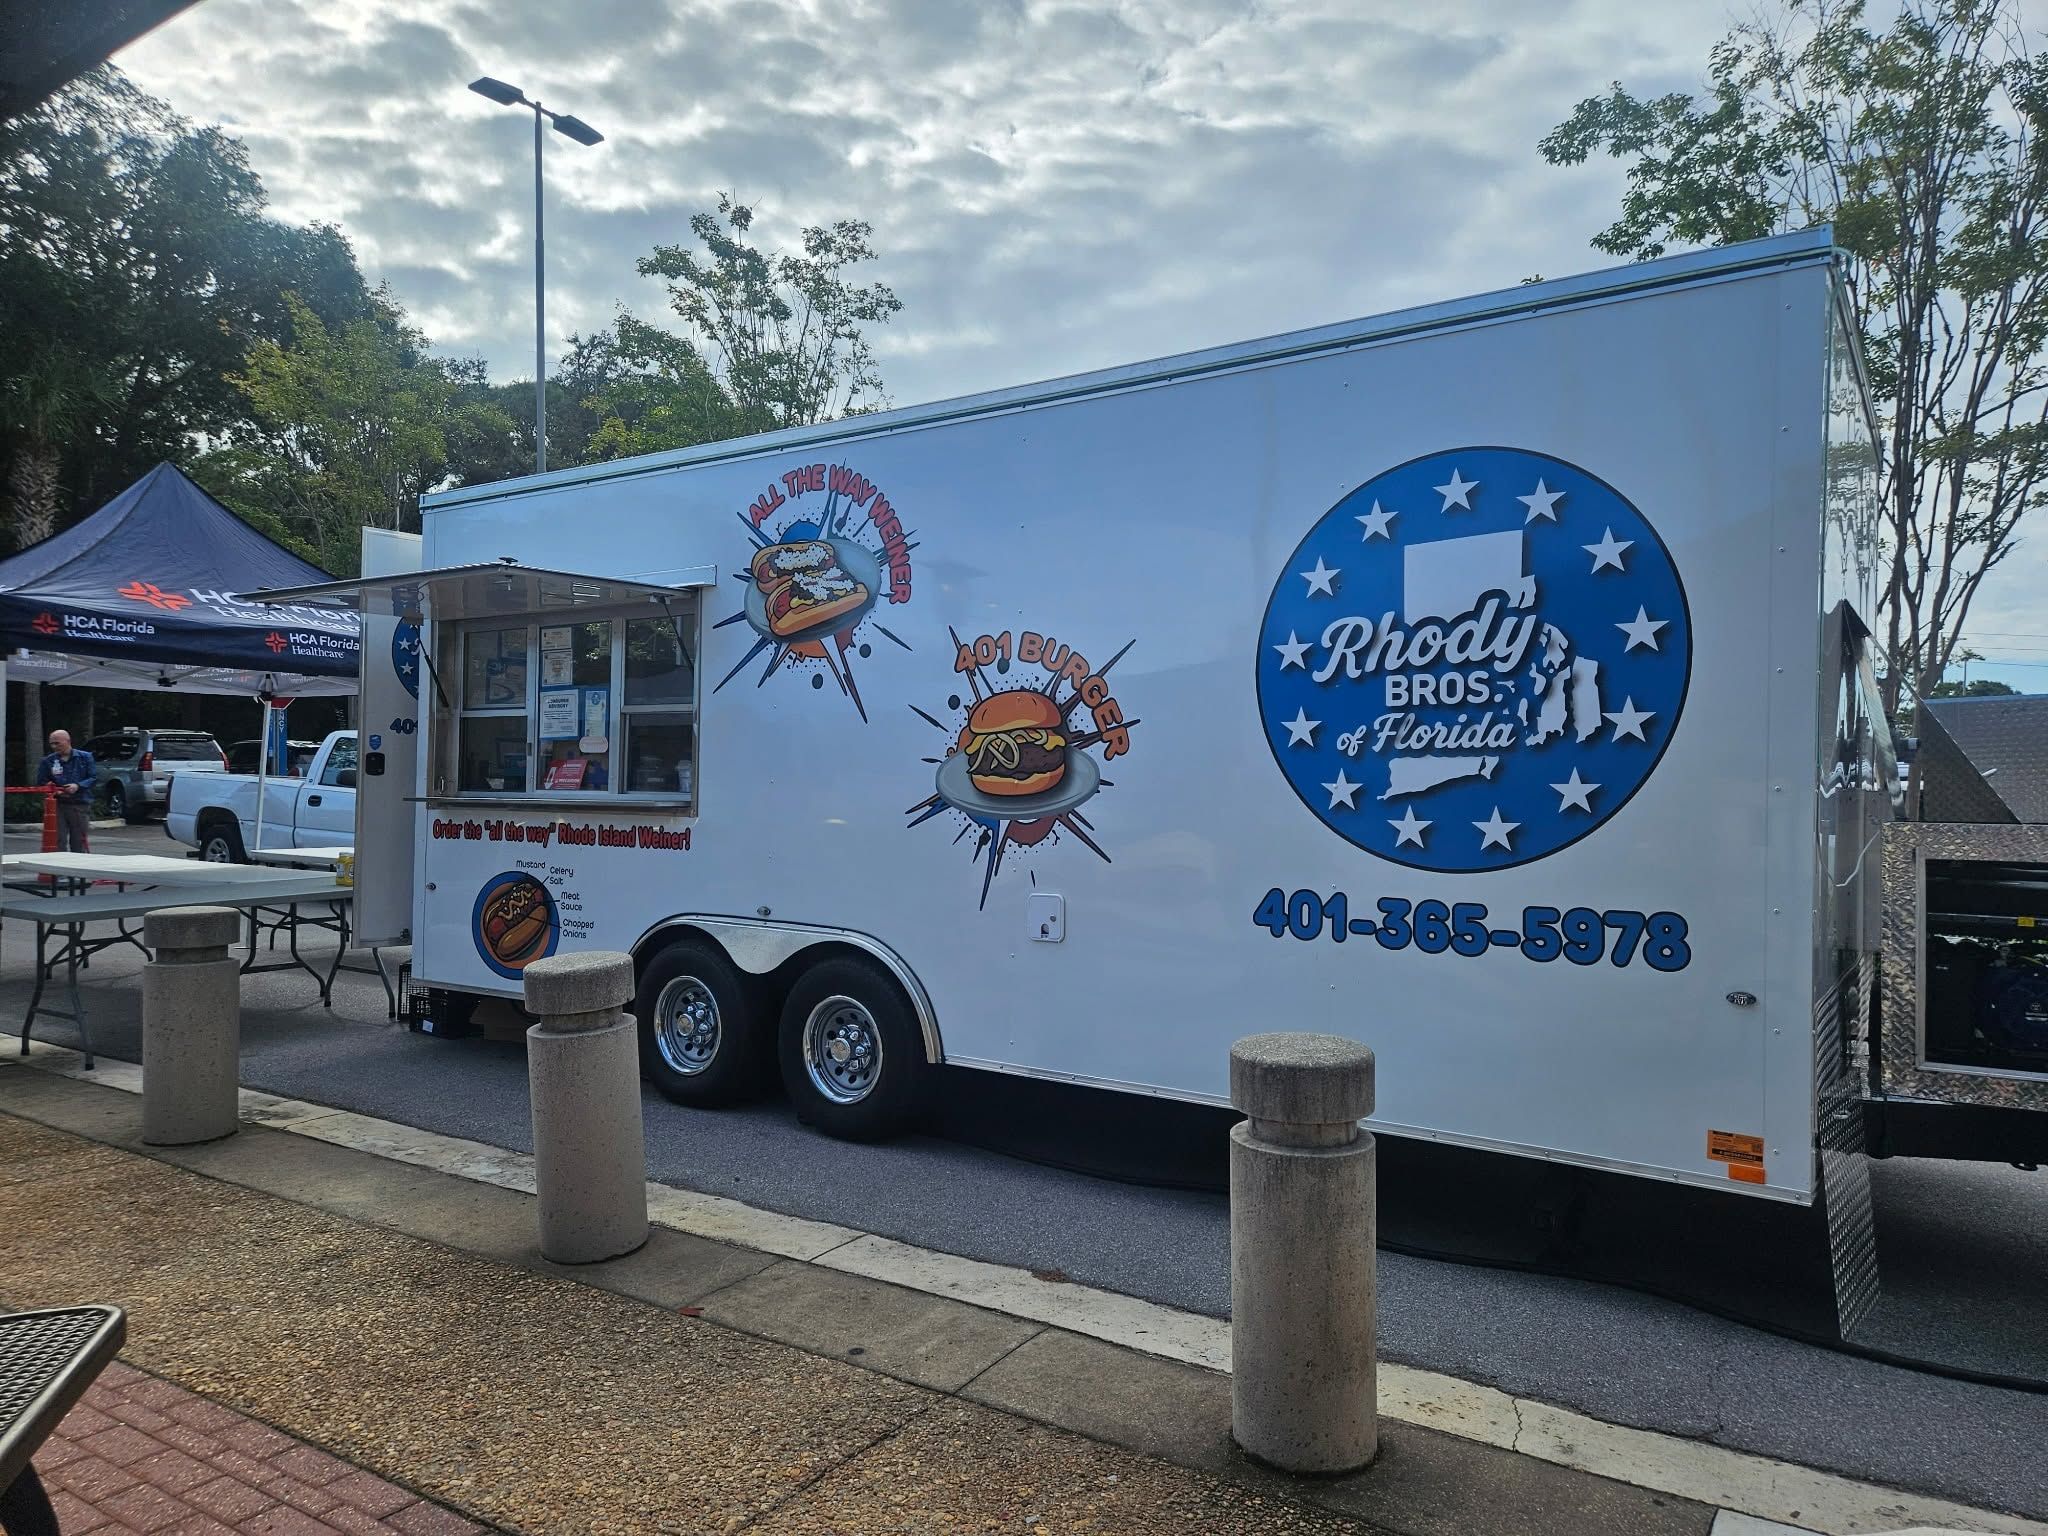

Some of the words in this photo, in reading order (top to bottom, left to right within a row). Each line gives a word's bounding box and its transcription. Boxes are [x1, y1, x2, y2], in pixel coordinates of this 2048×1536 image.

[748, 484, 786, 528] ALL
[782, 463, 826, 499] THE
[828, 463, 877, 508] WAY
[867, 493, 913, 605] WEINER
[63, 614, 100, 630] HCA
[102, 618, 155, 634] Florida
[64, 629, 136, 642] Healthcare
[289, 632, 317, 645] HCA
[319, 635, 360, 651] Florida
[1312, 597, 1537, 683] Rhody
[291, 645, 345, 659] Healthcare
[954, 630, 1012, 674] 401
[1018, 631, 1131, 761] BURGER
[1385, 670, 1504, 707] BROS.
[1336, 725, 1367, 757] of
[1371, 711, 1517, 753] Florida
[433, 818, 463, 839] Order
[464, 819, 483, 841] the
[504, 820, 525, 842] the
[558, 822, 596, 846] Rhode
[598, 824, 636, 848] Island
[638, 825, 691, 851] Weiner!
[516, 860, 546, 869] Mustard
[549, 866, 574, 877] Celery
[549, 876, 564, 885] Salt
[560, 891, 580, 901] Meat
[560, 901, 583, 911] Sauce
[562, 918, 595, 930] Chopped
[1252, 887, 1692, 973] 401-365-5978
[562, 928, 587, 939] Onions
